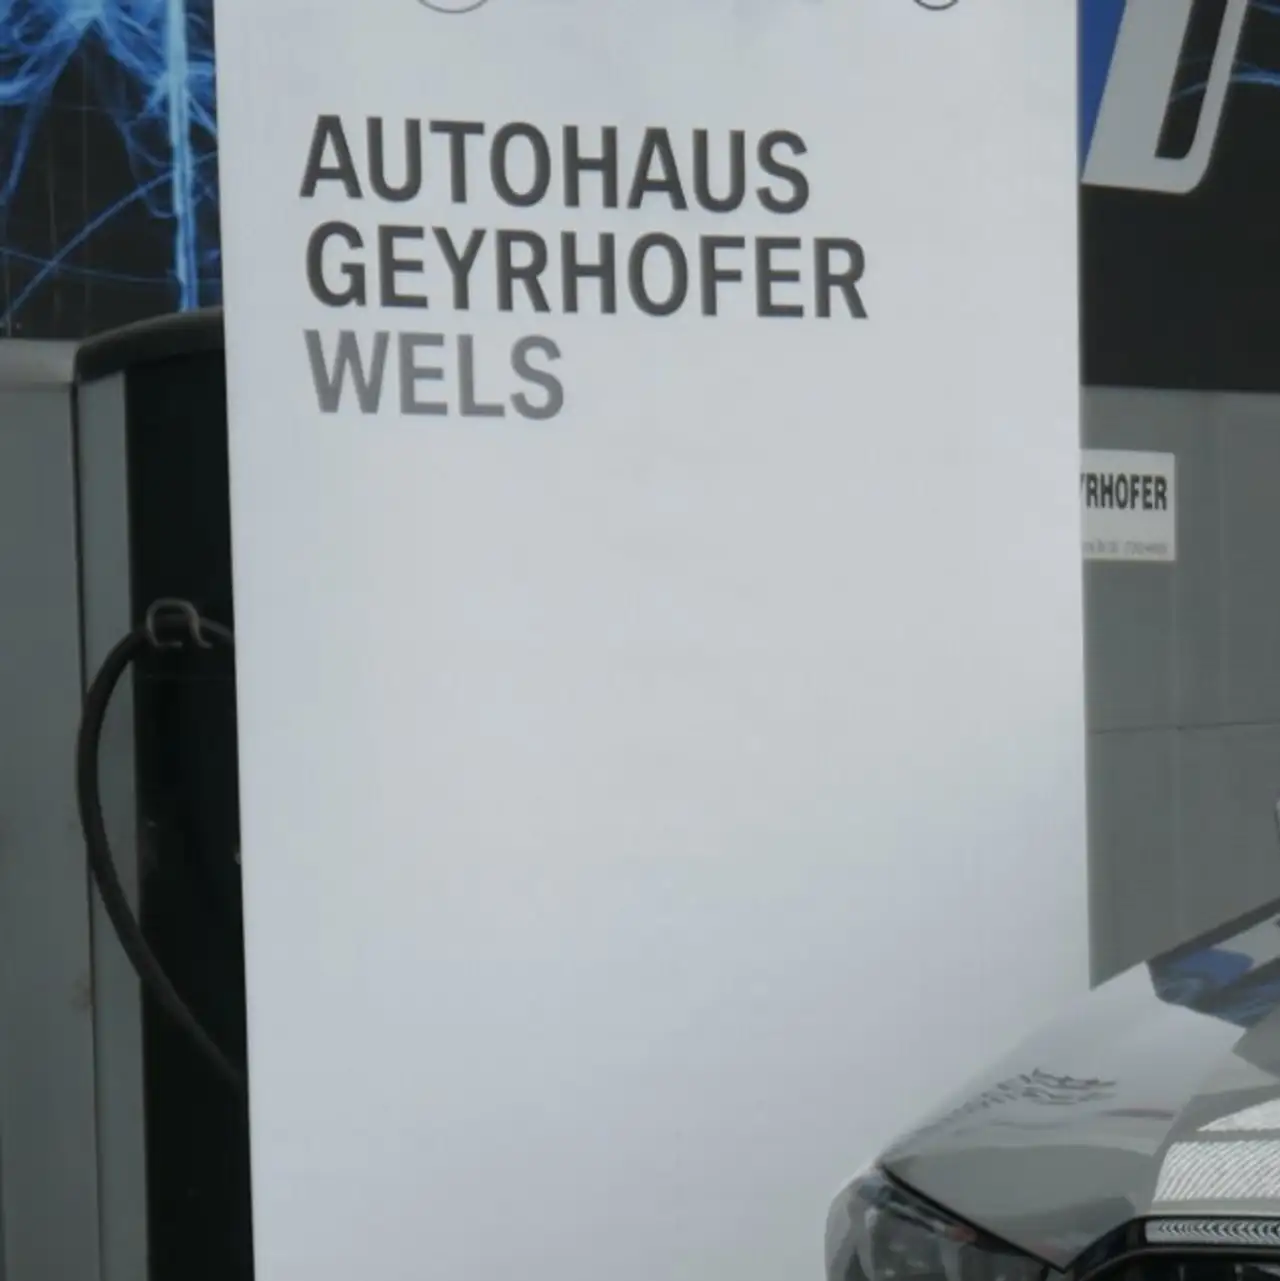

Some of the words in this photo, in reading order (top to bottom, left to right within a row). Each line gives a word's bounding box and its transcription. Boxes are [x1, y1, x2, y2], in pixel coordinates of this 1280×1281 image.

[299, 114, 810, 215] AUTOHAUS
[305, 220, 869, 320] GEYRHOFER
[303, 328, 564, 421] WELS
